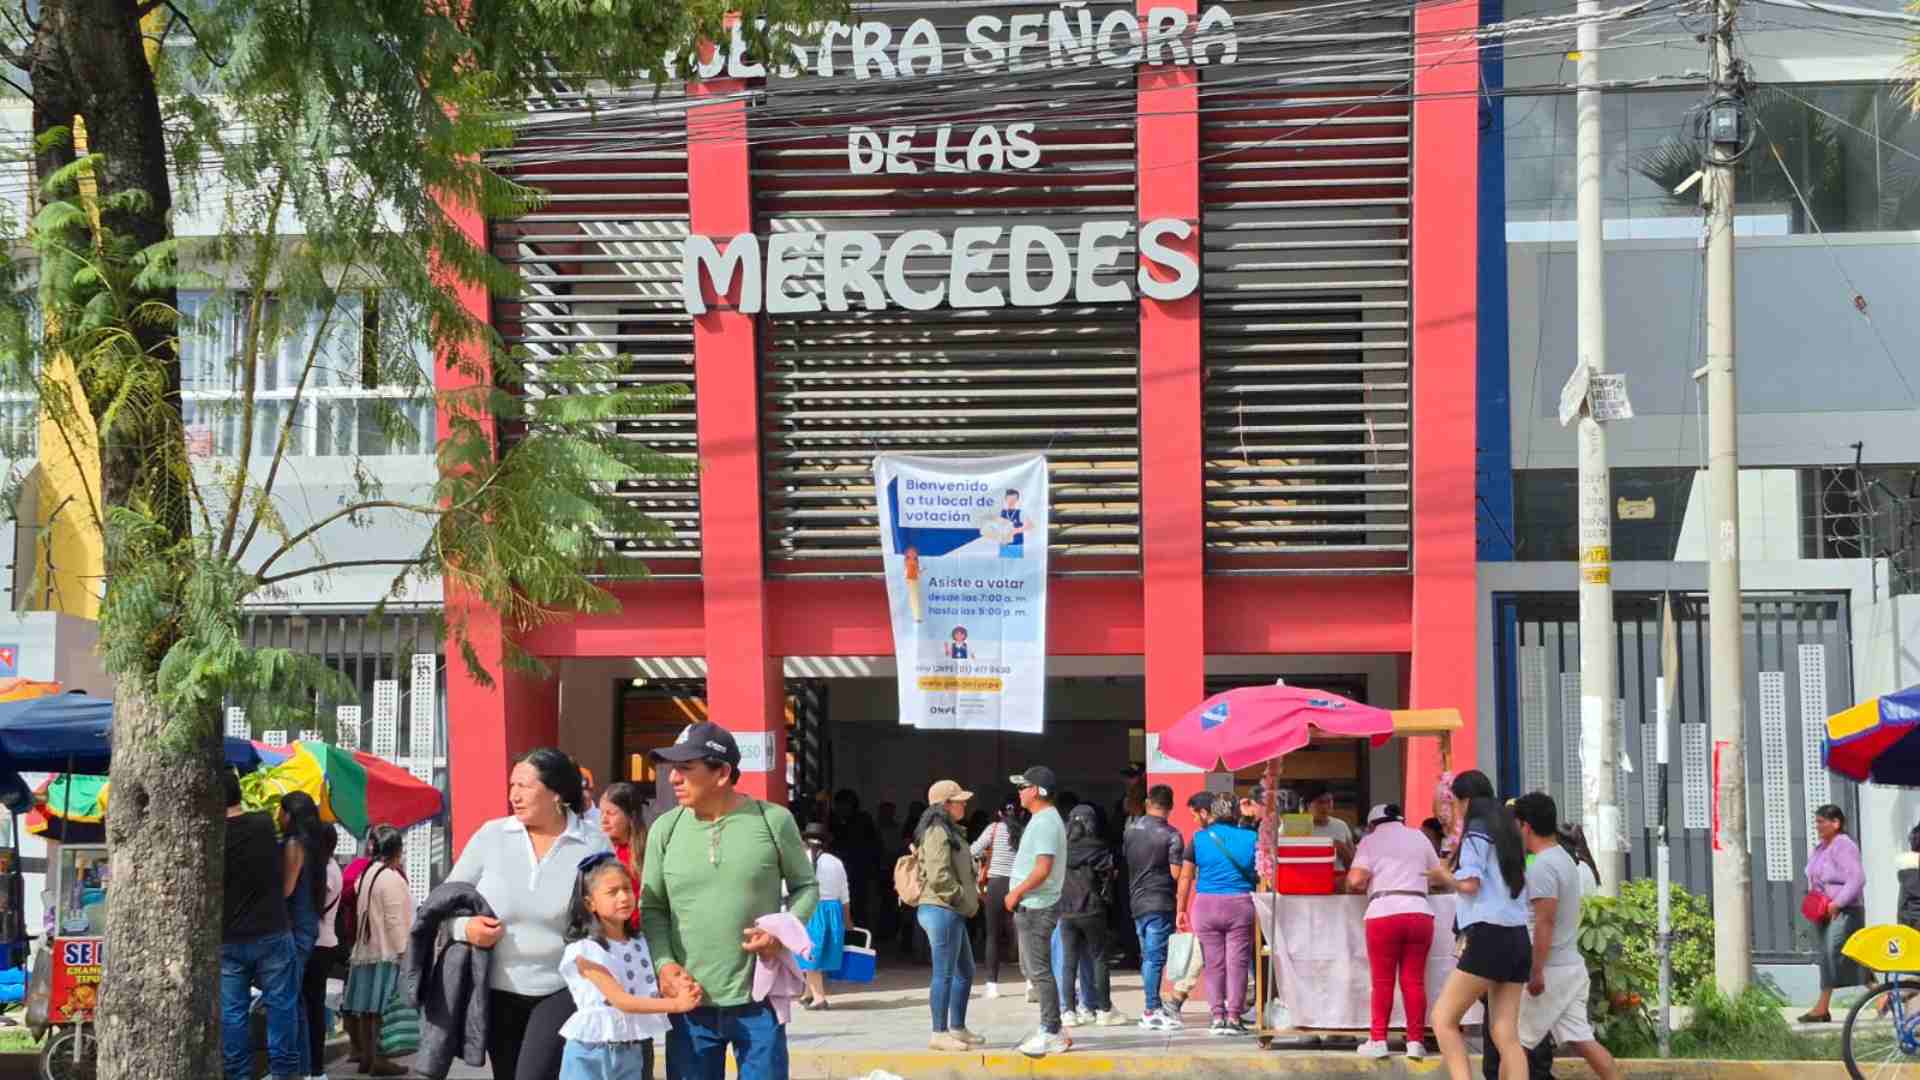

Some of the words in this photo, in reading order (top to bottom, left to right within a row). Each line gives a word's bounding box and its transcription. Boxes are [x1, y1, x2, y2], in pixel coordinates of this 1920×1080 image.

[963, 1, 1238, 74] SEÑORA
[848, 125, 918, 174] DE
[934, 122, 1041, 173] LAS
[683, 217, 1200, 314] MERCEDES
[906, 479, 989, 492] Bienvenido
[906, 496, 914, 505] a
[919, 496, 934, 505] tu
[937, 496, 973, 506] local
[976, 497, 994, 507] de
[905, 510, 971, 522] votación
[929, 577, 971, 588] Asiste
[975, 580, 984, 588] a
[987, 578, 1024, 589] votar
[64, 941, 93, 966] SE
